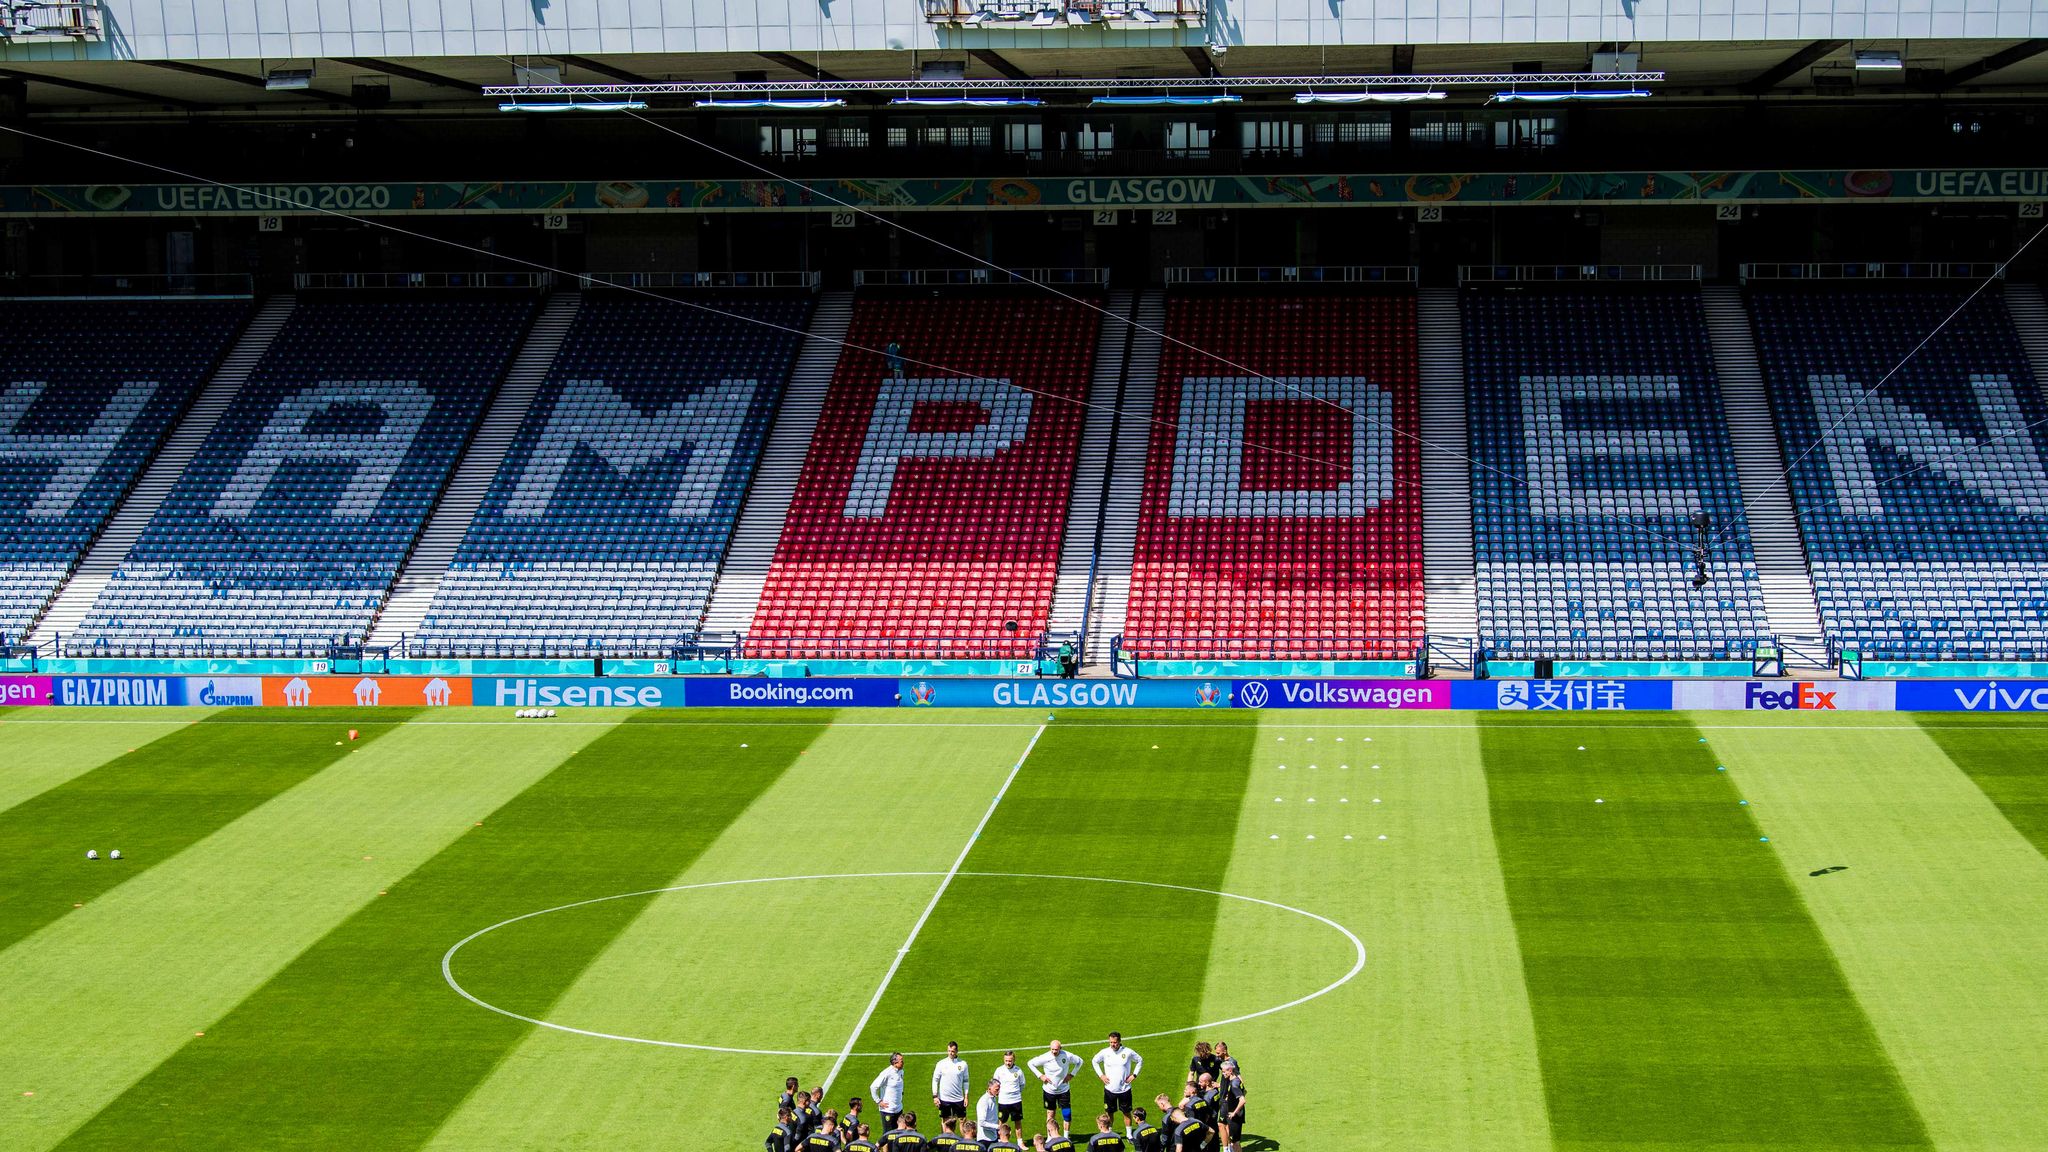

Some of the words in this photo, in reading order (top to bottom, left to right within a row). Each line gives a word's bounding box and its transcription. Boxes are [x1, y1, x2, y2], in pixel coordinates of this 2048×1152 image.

[1916, 171, 1995, 195] UEFA
[1067, 178, 1216, 203] GLASGOW
[158, 186, 232, 209] UEFA
[237, 186, 313, 209] EURO
[319, 186, 390, 209] 2020
[1421, 208, 1440, 220] 23
[1720, 205, 1738, 217] 24
[2022, 204, 2041, 216] 25
[549, 215, 563, 227] 19
[834, 213, 853, 225] 20
[1098, 211, 1114, 223] 21
[1155, 211, 1173, 222] 22
[263, 217, 278, 229] 18
[316, 662, 326, 671] 19
[656, 664, 668, 672] 20
[1019, 664, 1030, 673] 21
[62, 679, 167, 705] GAZPROM
[495, 680, 662, 706] Hisense
[730, 683, 853, 703] Booking.com
[993, 682, 1138, 705] GLASGOW
[1282, 683, 1432, 707] Volkswagen
[1745, 682, 1837, 709] FedEx
[215, 695, 253, 705] GAZPROM
